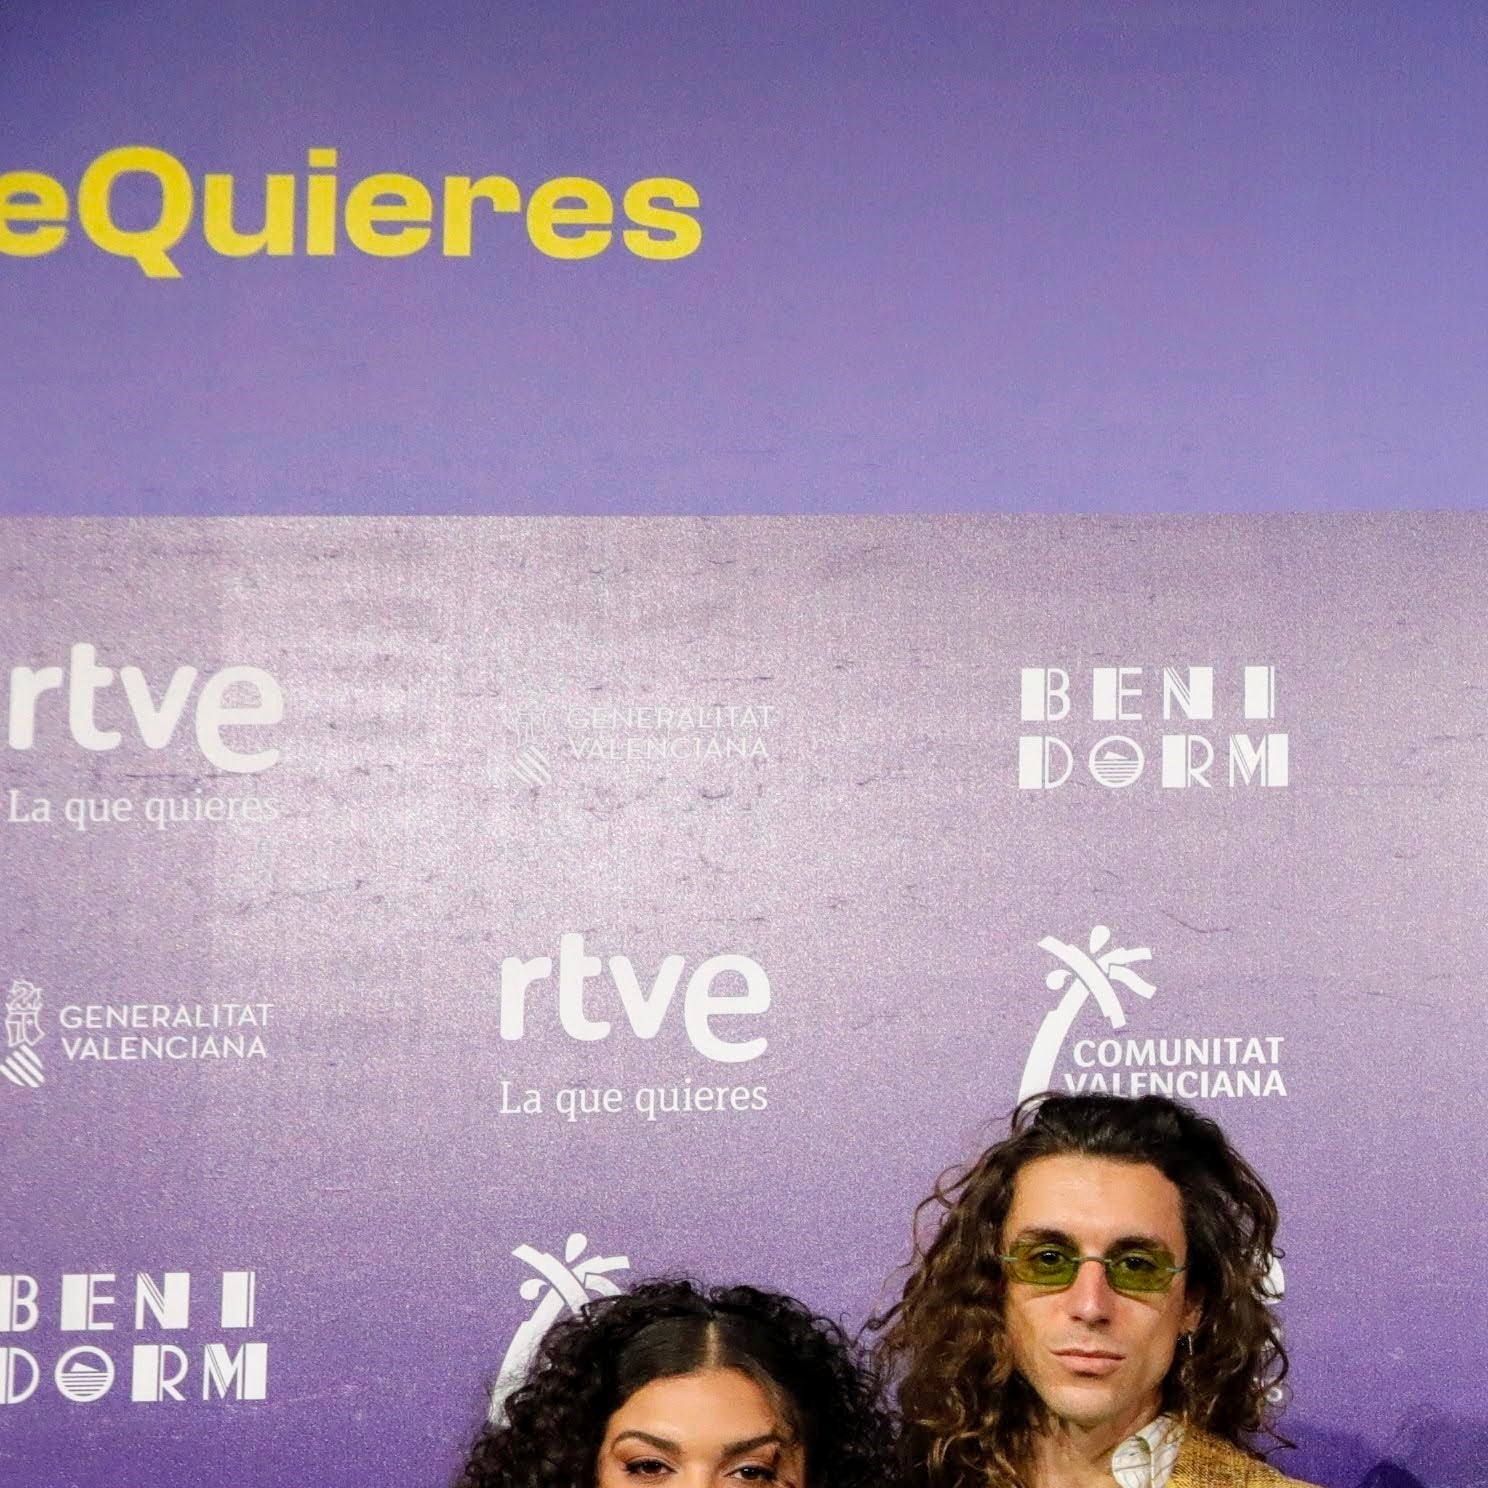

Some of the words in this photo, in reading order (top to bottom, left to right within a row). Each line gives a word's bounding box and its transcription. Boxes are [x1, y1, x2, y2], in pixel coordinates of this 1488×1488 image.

[0, 147, 702, 278] eQuieres
[8, 642, 284, 774] rtve
[1020, 666, 1276, 721] BENI
[567, 705, 774, 730] GENERALITAT
[568, 734, 770, 760] VALENCIANA
[1018, 733, 1289, 789] DORM
[8, 789, 52, 823] La
[64, 798, 134, 831] que
[145, 788, 281, 830] quieres
[60, 1003, 274, 1029] GENERALITAT
[500, 932, 771, 1062] rtve
[62, 1034, 269, 1060] VALENCIANA
[1073, 1036, 1284, 1067] COMUNITAT
[499, 1081, 543, 1114] La
[556, 1088, 623, 1122] que
[635, 1078, 768, 1121] quieres
